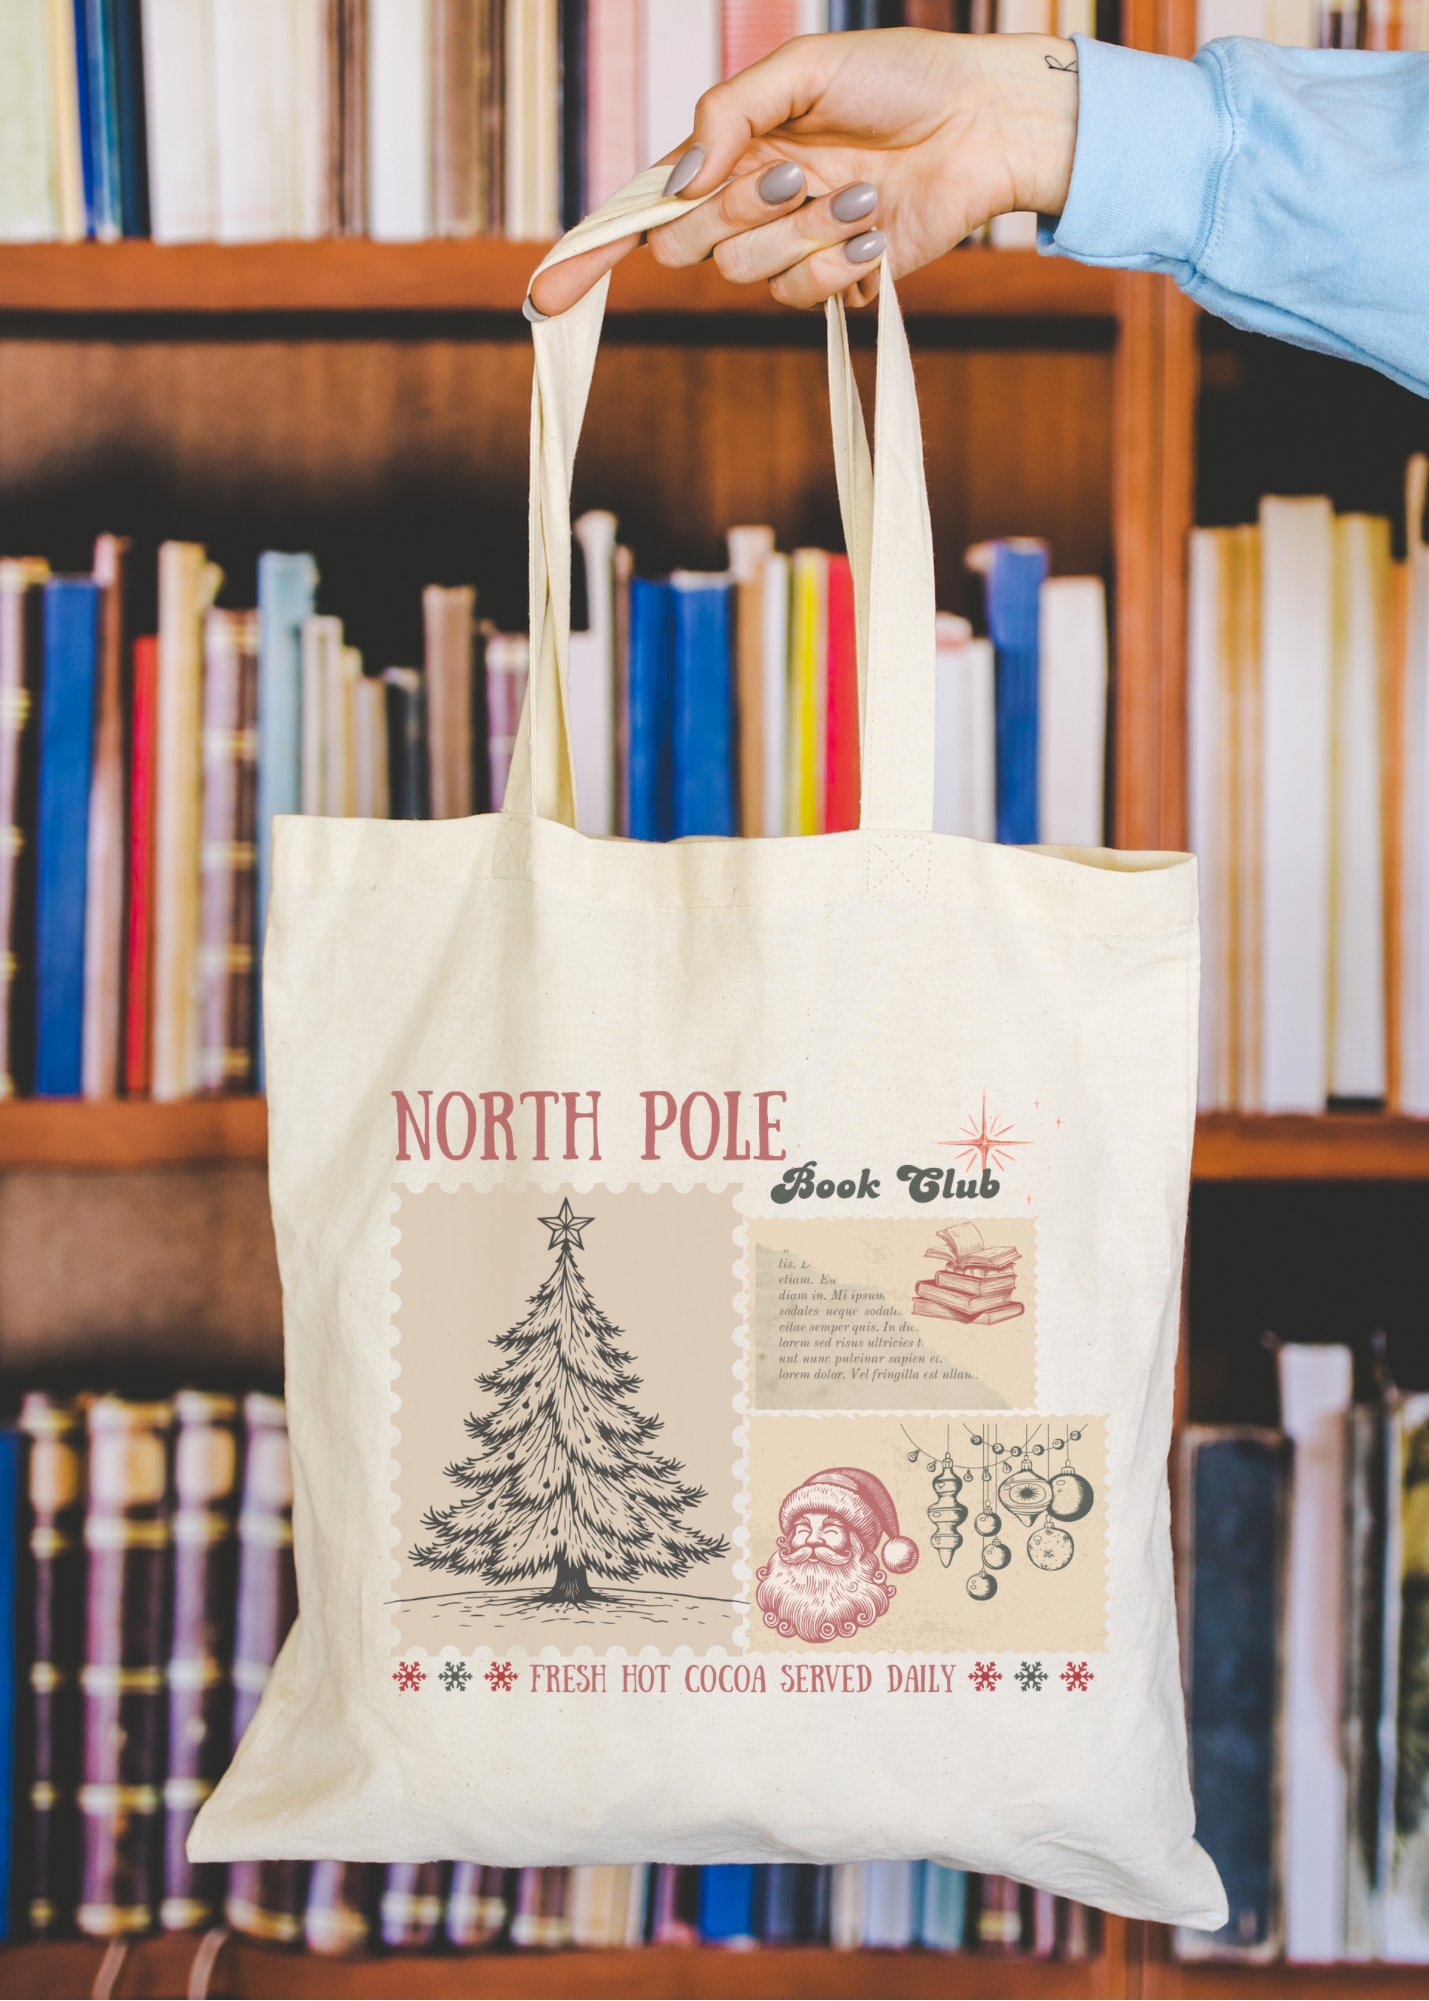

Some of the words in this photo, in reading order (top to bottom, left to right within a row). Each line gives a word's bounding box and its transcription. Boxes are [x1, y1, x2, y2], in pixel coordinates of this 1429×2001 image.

[390, 1090, 602, 1161] NORTH
[639, 1090, 787, 1161] POLE
[770, 1160, 881, 1205] Book
[896, 1164, 1001, 1204] Club
[778, 1274, 814, 1285] etiam.
[778, 1289, 808, 1301] diam
[811, 1289, 827, 1301] in.
[830, 1289, 848, 1301] Mi
[778, 1305, 820, 1316] sodales
[826, 1308, 859, 1320] neque
[778, 1321, 807, 1332] vitae
[808, 1323, 850, 1335] semper
[851, 1321, 880, 1335] quis.
[882, 1321, 896, 1332] In
[778, 1336, 810, 1348] lorem
[813, 1336, 833, 1348] sed
[835, 1337, 865, 1348] risus
[867, 1336, 915, 1348] ultricies
[778, 1352, 798, 1364] unt
[802, 1355, 831, 1364] nunc
[834, 1352, 886, 1367] pulvinar
[888, 1352, 926, 1367] sapien
[778, 1368, 810, 1380] lorem
[813, 1368, 846, 1380] dolor.
[850, 1368, 870, 1380] Vel
[871, 1368, 920, 1383] fringilla
[923, 1368, 939, 1380] est
[529, 1664, 607, 1693] FRESH
[621, 1664, 671, 1693] HOT
[684, 1664, 767, 1693] COCOA
[780, 1664, 872, 1693] SERVED
[886, 1664, 957, 1693] DAILY
